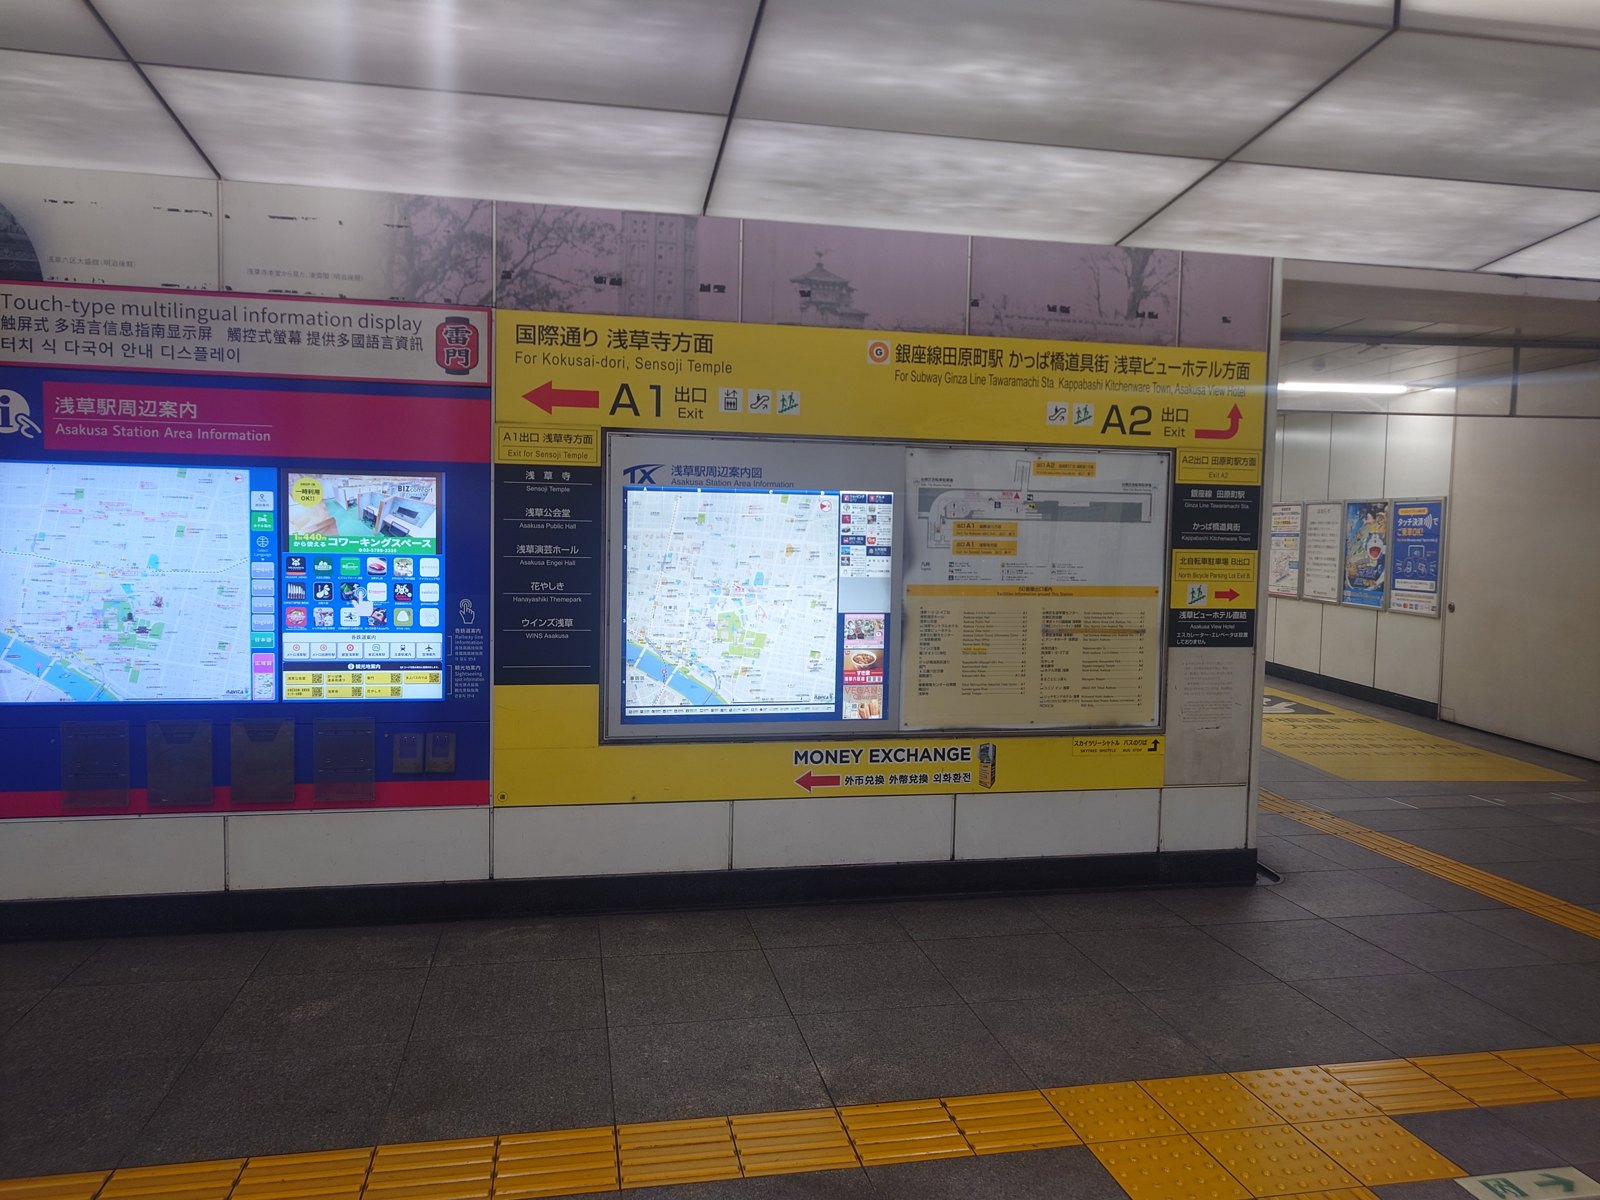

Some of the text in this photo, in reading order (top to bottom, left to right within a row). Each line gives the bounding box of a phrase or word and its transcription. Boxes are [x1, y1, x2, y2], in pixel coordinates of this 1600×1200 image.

[0, 293, 423, 335] Touch-type multilingual information display
[0, 315, 424, 351] 触屏式 多语言信息指南显示屏 觸控式螢幕 提供多國語言資訊
[515, 324, 713, 355] 国際通り 浅草寺方面
[41, 338, 56, 355] 식
[65, 339, 113, 357] 다국어
[121, 342, 153, 359] 안내
[161, 345, 240, 363] 디스플레이
[443, 325, 472, 367] 雷門
[515, 351, 733, 375] For Kokusai-dori, Sensoji Temple
[895, 344, 1251, 381] 銀座線田原町駅 かっぱ橋道具街 浅草ビューホテル方面
[895, 369, 908, 382] For
[910, 371, 942, 386] Subway
[944, 372, 967, 386] Ginza
[970, 373, 986, 386] Line
[988, 374, 1040, 389] Tawaramachi
[1058, 377, 1103, 392] Kappabashi
[1105, 379, 1150, 393] Kitchenware
[1175, 383, 1206, 396] Asakusa
[1208, 384, 1225, 396] View
[1227, 385, 1246, 397] Hotel
[609, 383, 662, 417] A1
[674, 386, 707, 404] 出口
[54, 396, 198, 420] 浅草駅周辺案内
[678, 407, 704, 420] Exit
[1101, 405, 1152, 436] A2
[1161, 407, 1189, 423] 出口
[55, 423, 271, 442] Asakusa Station Area Information
[1163, 426, 1186, 438] Exit
[543, 433, 593, 444] 浅草寺方面
[523, 450, 533, 458] for
[535, 451, 561, 460] Sensoji
[564, 452, 588, 460] Temple
[1182, 456, 1257, 467] A2出口 田原町駅方面
[671, 465, 762, 479] 浅草駅周辺案内図
[526, 485, 547, 493] Sensoji
[671, 478, 794, 489] Asakusa Station Area Information
[1216, 490, 1246, 499] 田原町駅
[525, 508, 571, 518] 浅草公会堂
[1192, 522, 1241, 532] かっぱ橋道具街
[328, 537, 432, 549] コワーキングスペース
[516, 545, 579, 555] 浅草演芸ホール
[519, 559, 545, 567] Asakusa
[1180, 558, 1229, 566] 北自転車駐車場
[530, 582, 565, 591] 花やしき
[1178, 611, 1247, 620] 浅草ビューホテル直結
[521, 618, 574, 628] ウインズ浅草
[794, 747, 971, 765] MONEY EXCHANGE
[933, 772, 971, 783] 외화환전
